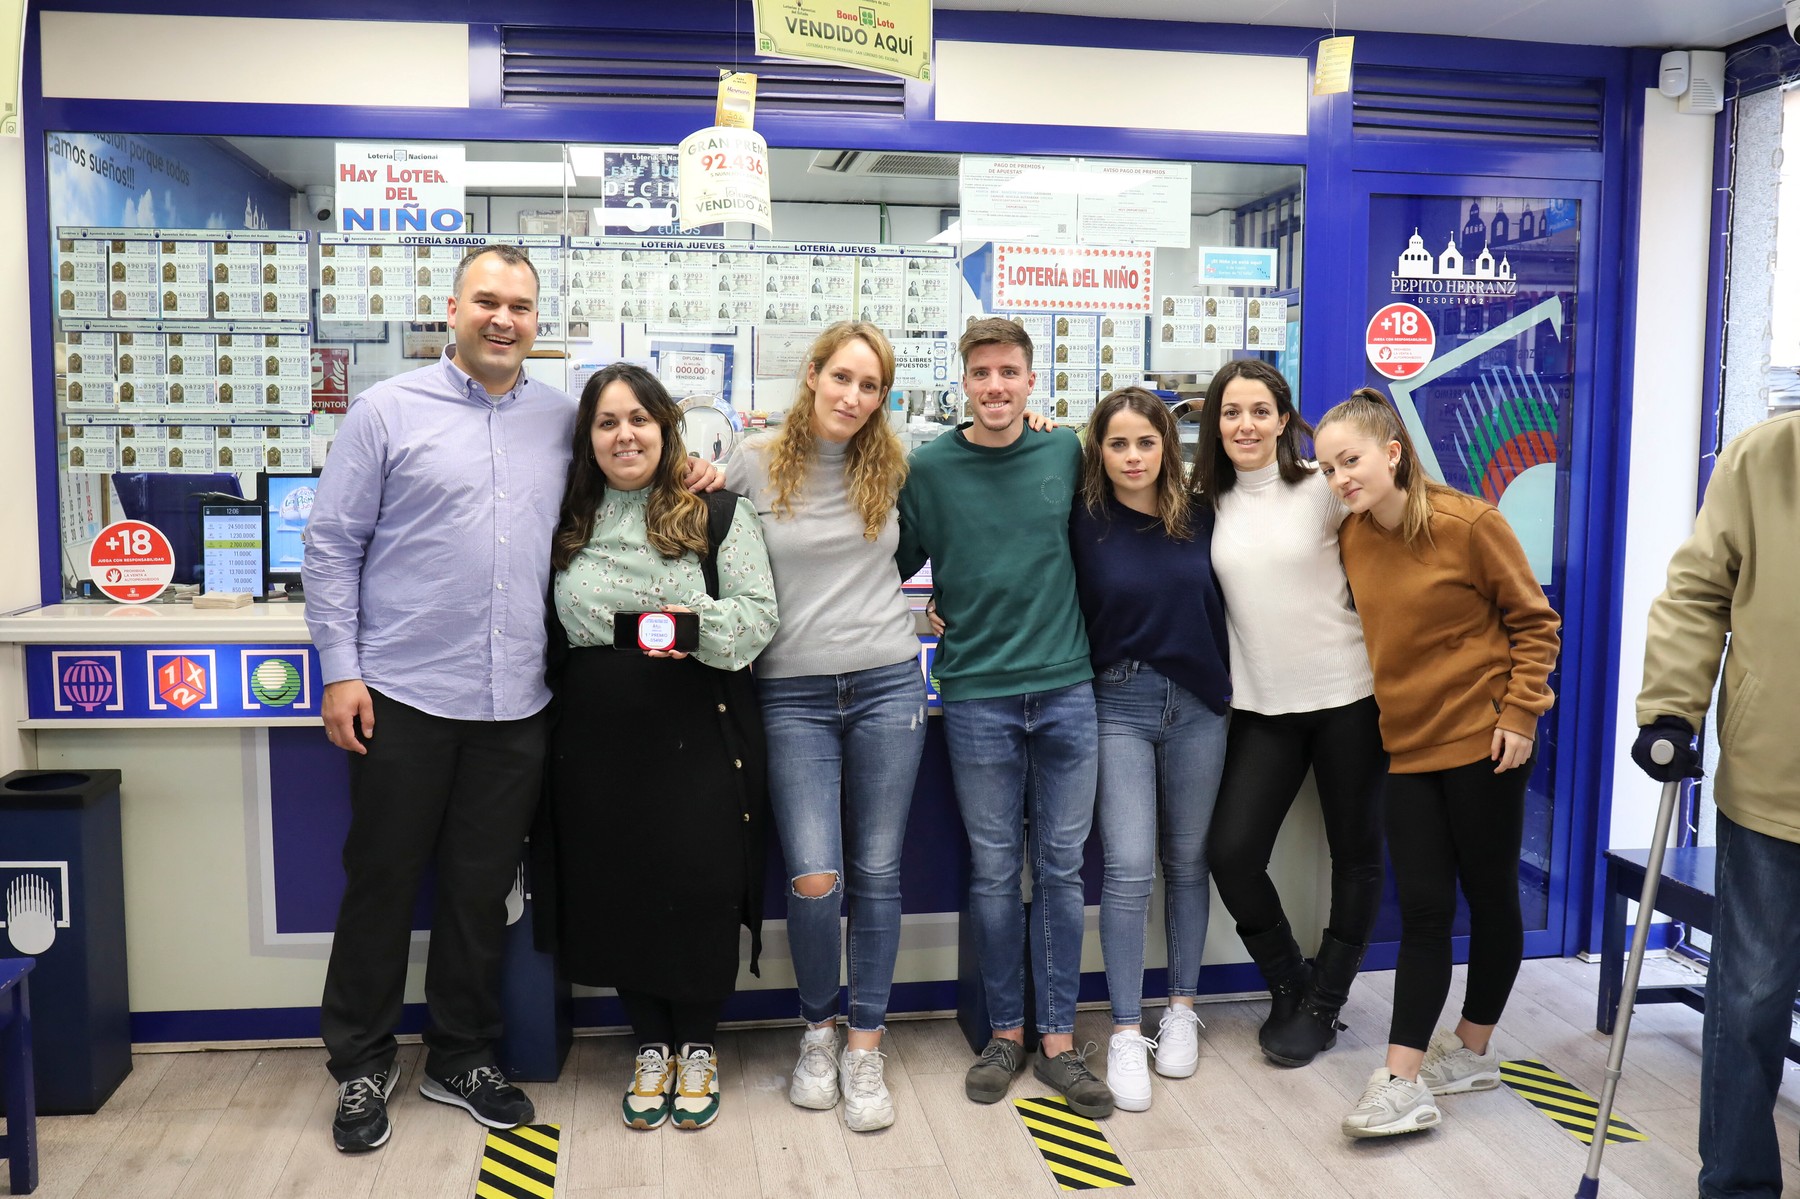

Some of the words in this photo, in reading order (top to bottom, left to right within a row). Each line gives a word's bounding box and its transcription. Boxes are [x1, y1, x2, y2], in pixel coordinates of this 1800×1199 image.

[836, 10, 858, 22] Bono
[877, 18, 895, 29] Loto
[785, 16, 868, 46] VENDIDO
[874, 32, 913, 56] AQUÍ
[89, 153, 135, 190] sueños!!!
[166, 159, 190, 186] todos
[387, 165, 448, 183] LOTER
[386, 187, 417, 200] DEL
[696, 199, 754, 212] VENDIDO
[343, 203, 463, 231] NIÑO
[398, 236, 442, 244] LOTERÍA
[445, 237, 486, 245] SABADO
[641, 240, 684, 249] LOTERÍA
[794, 244, 836, 252] LOTERÍA
[838, 245, 876, 253] JUEVES
[1008, 263, 1068, 287] LOTERÍA
[1073, 269, 1099, 288] DEL
[1103, 266, 1139, 289] NIÑO
[1391, 279, 1443, 293] PEPITO
[1446, 280, 1517, 295] HERRANZ
[1380, 312, 1418, 336] +18
[70, 514, 75, 526] 23
[78, 512, 83, 524] 24
[87, 509, 93, 522] 25
[106, 529, 152, 555] +18
